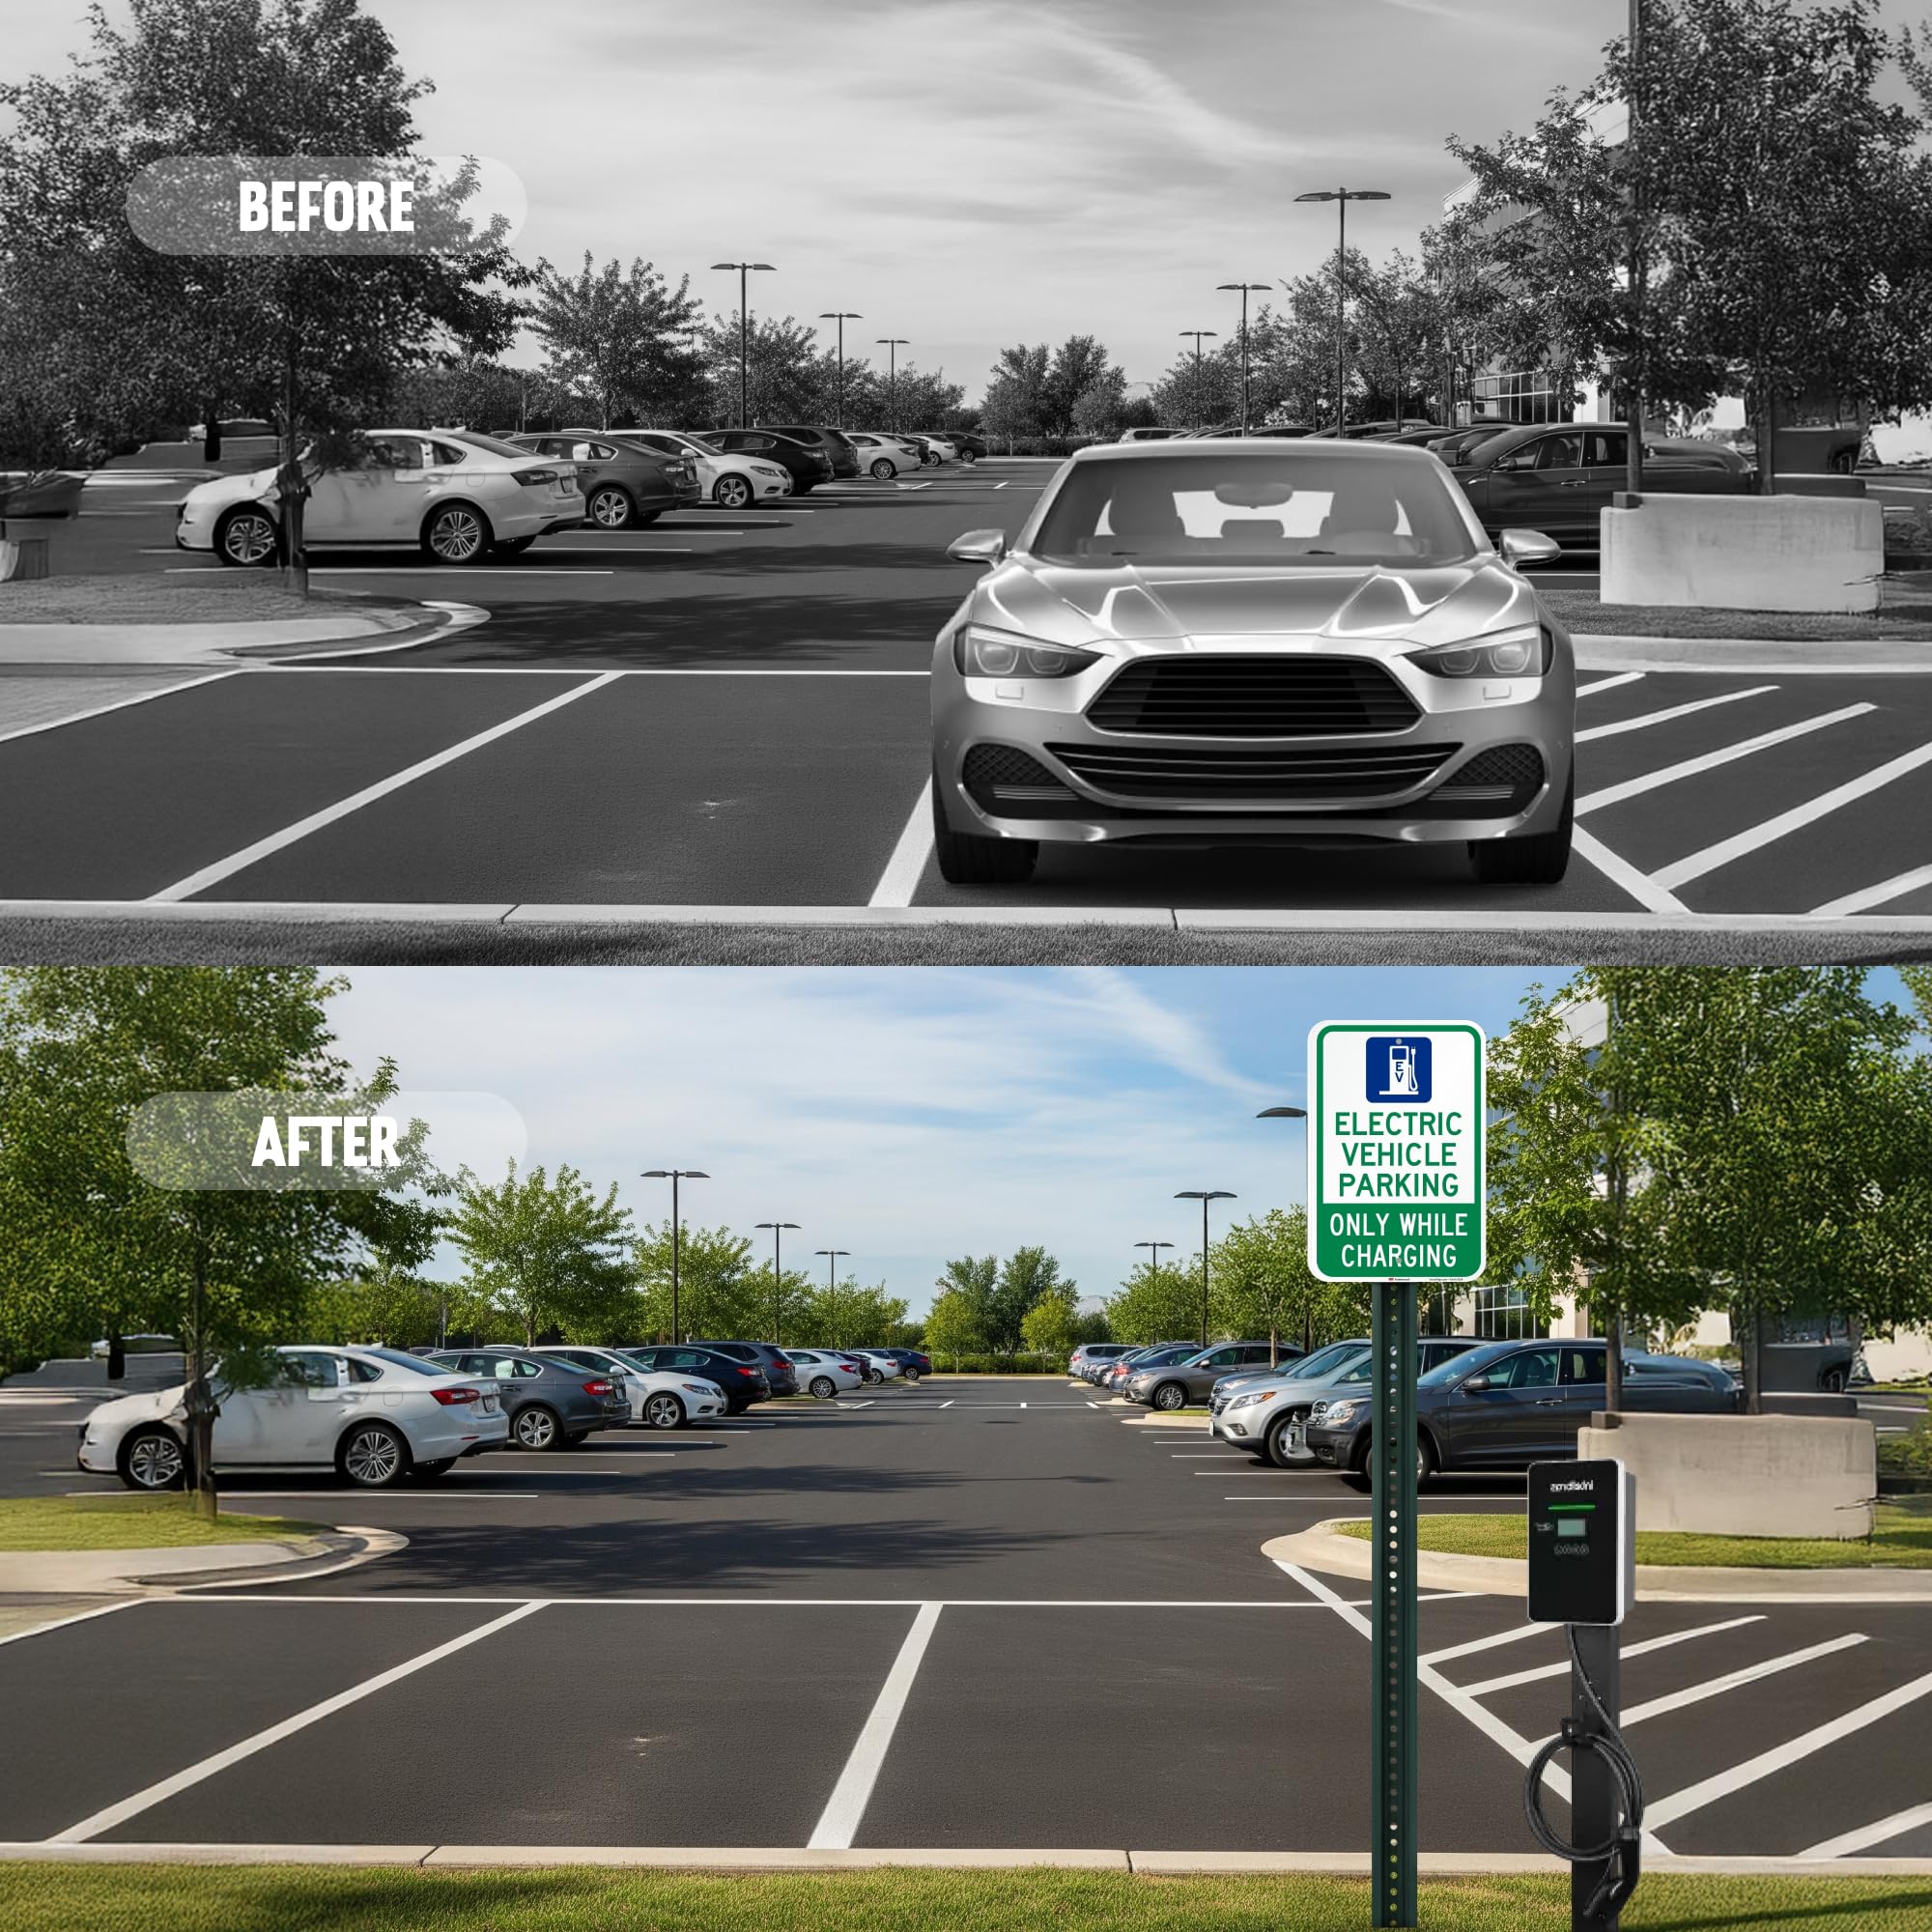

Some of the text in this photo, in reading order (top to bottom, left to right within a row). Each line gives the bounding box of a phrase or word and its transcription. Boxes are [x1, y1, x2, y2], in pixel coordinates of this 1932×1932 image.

[1335, 1111, 1463, 1136] ELECTRIC
[1342, 1142, 1457, 1167] VEHICLE
[1339, 1173, 1459, 1198] PARKING
[1329, 1212, 1468, 1236] ONLY WHILE
[1341, 1243, 1457, 1268] CHARGING
